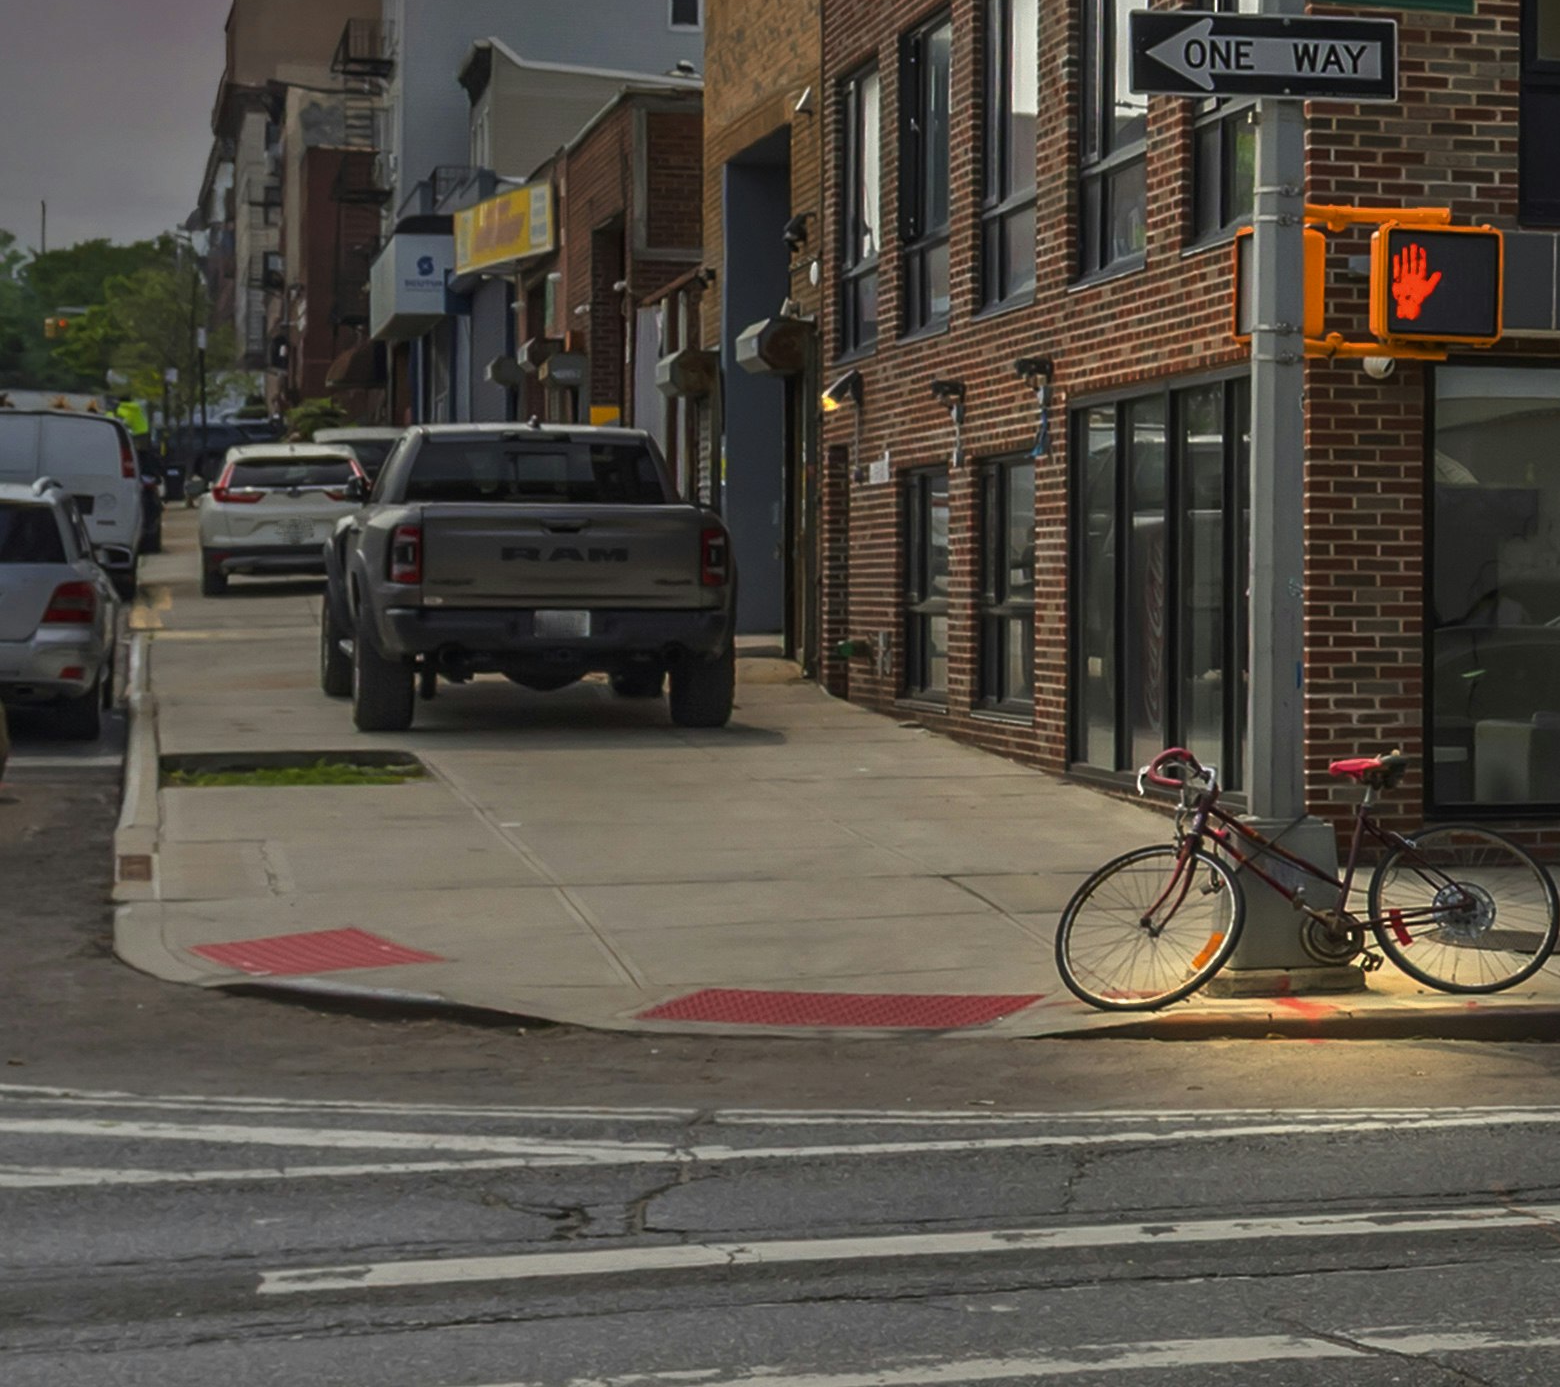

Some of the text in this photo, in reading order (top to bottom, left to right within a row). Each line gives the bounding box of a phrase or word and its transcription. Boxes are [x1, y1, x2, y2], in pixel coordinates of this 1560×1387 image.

[1183, 39, 1368, 75] ONE WAY
[501, 547, 628, 562] RAM
